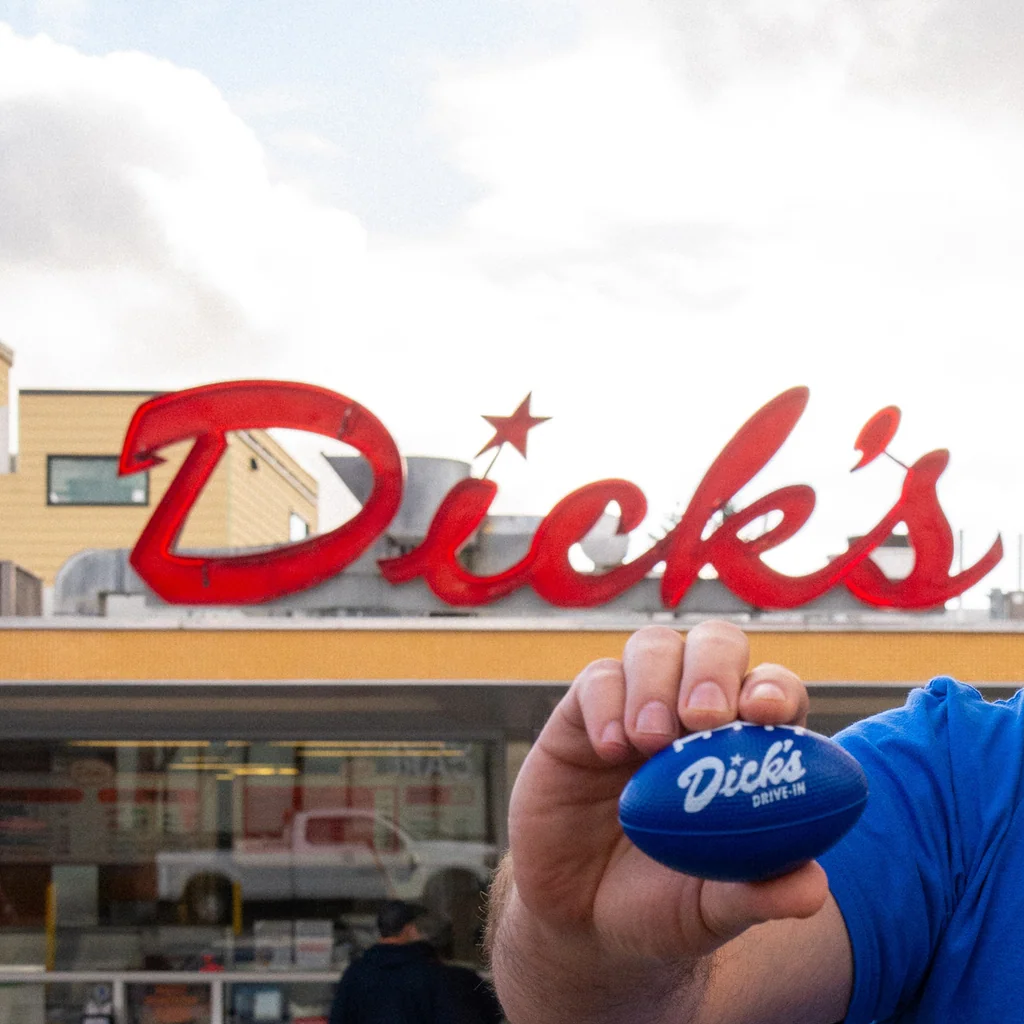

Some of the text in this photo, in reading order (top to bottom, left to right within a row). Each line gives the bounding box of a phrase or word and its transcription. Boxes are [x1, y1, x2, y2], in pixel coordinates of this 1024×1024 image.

[117, 379, 1003, 610] Dick's
[677, 739, 806, 813] Dick's
[752, 781, 806, 808] DRIVE-IN
